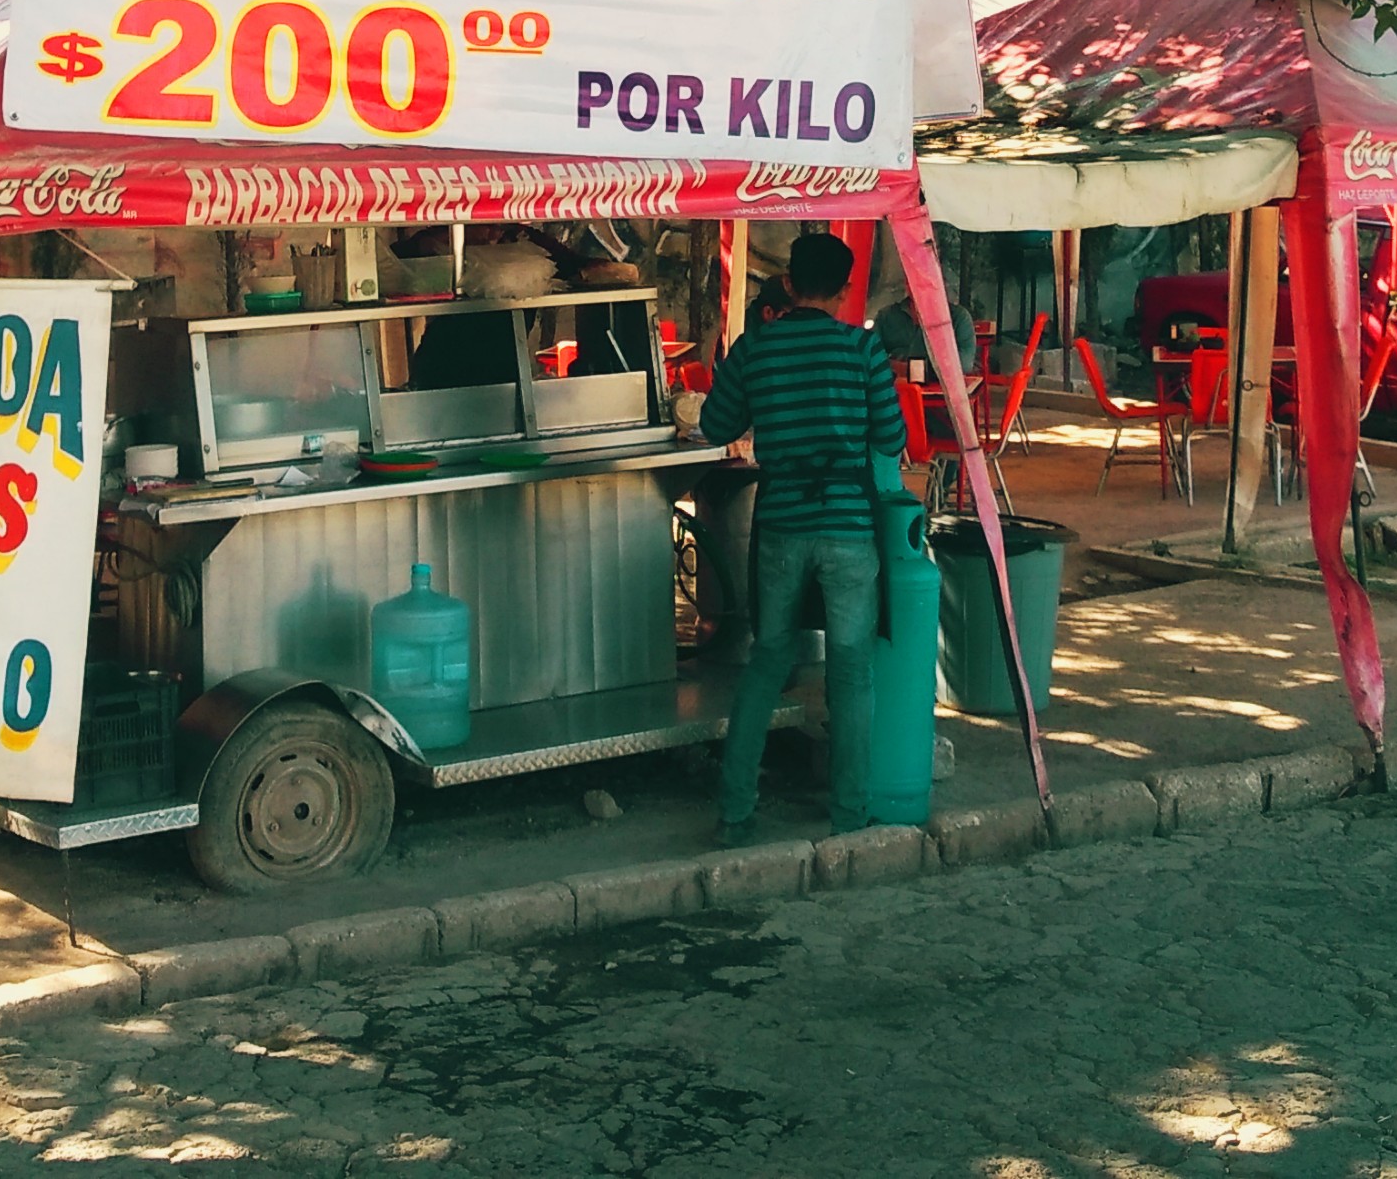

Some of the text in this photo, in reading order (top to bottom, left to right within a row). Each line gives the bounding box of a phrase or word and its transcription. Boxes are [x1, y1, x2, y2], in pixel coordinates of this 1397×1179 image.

[577, 71, 704, 135] POR
[728, 76, 876, 142] KILO
[185, 167, 365, 226] BARBACOA
[368, 167, 414, 222] DE
[417, 166, 480, 222] RES
